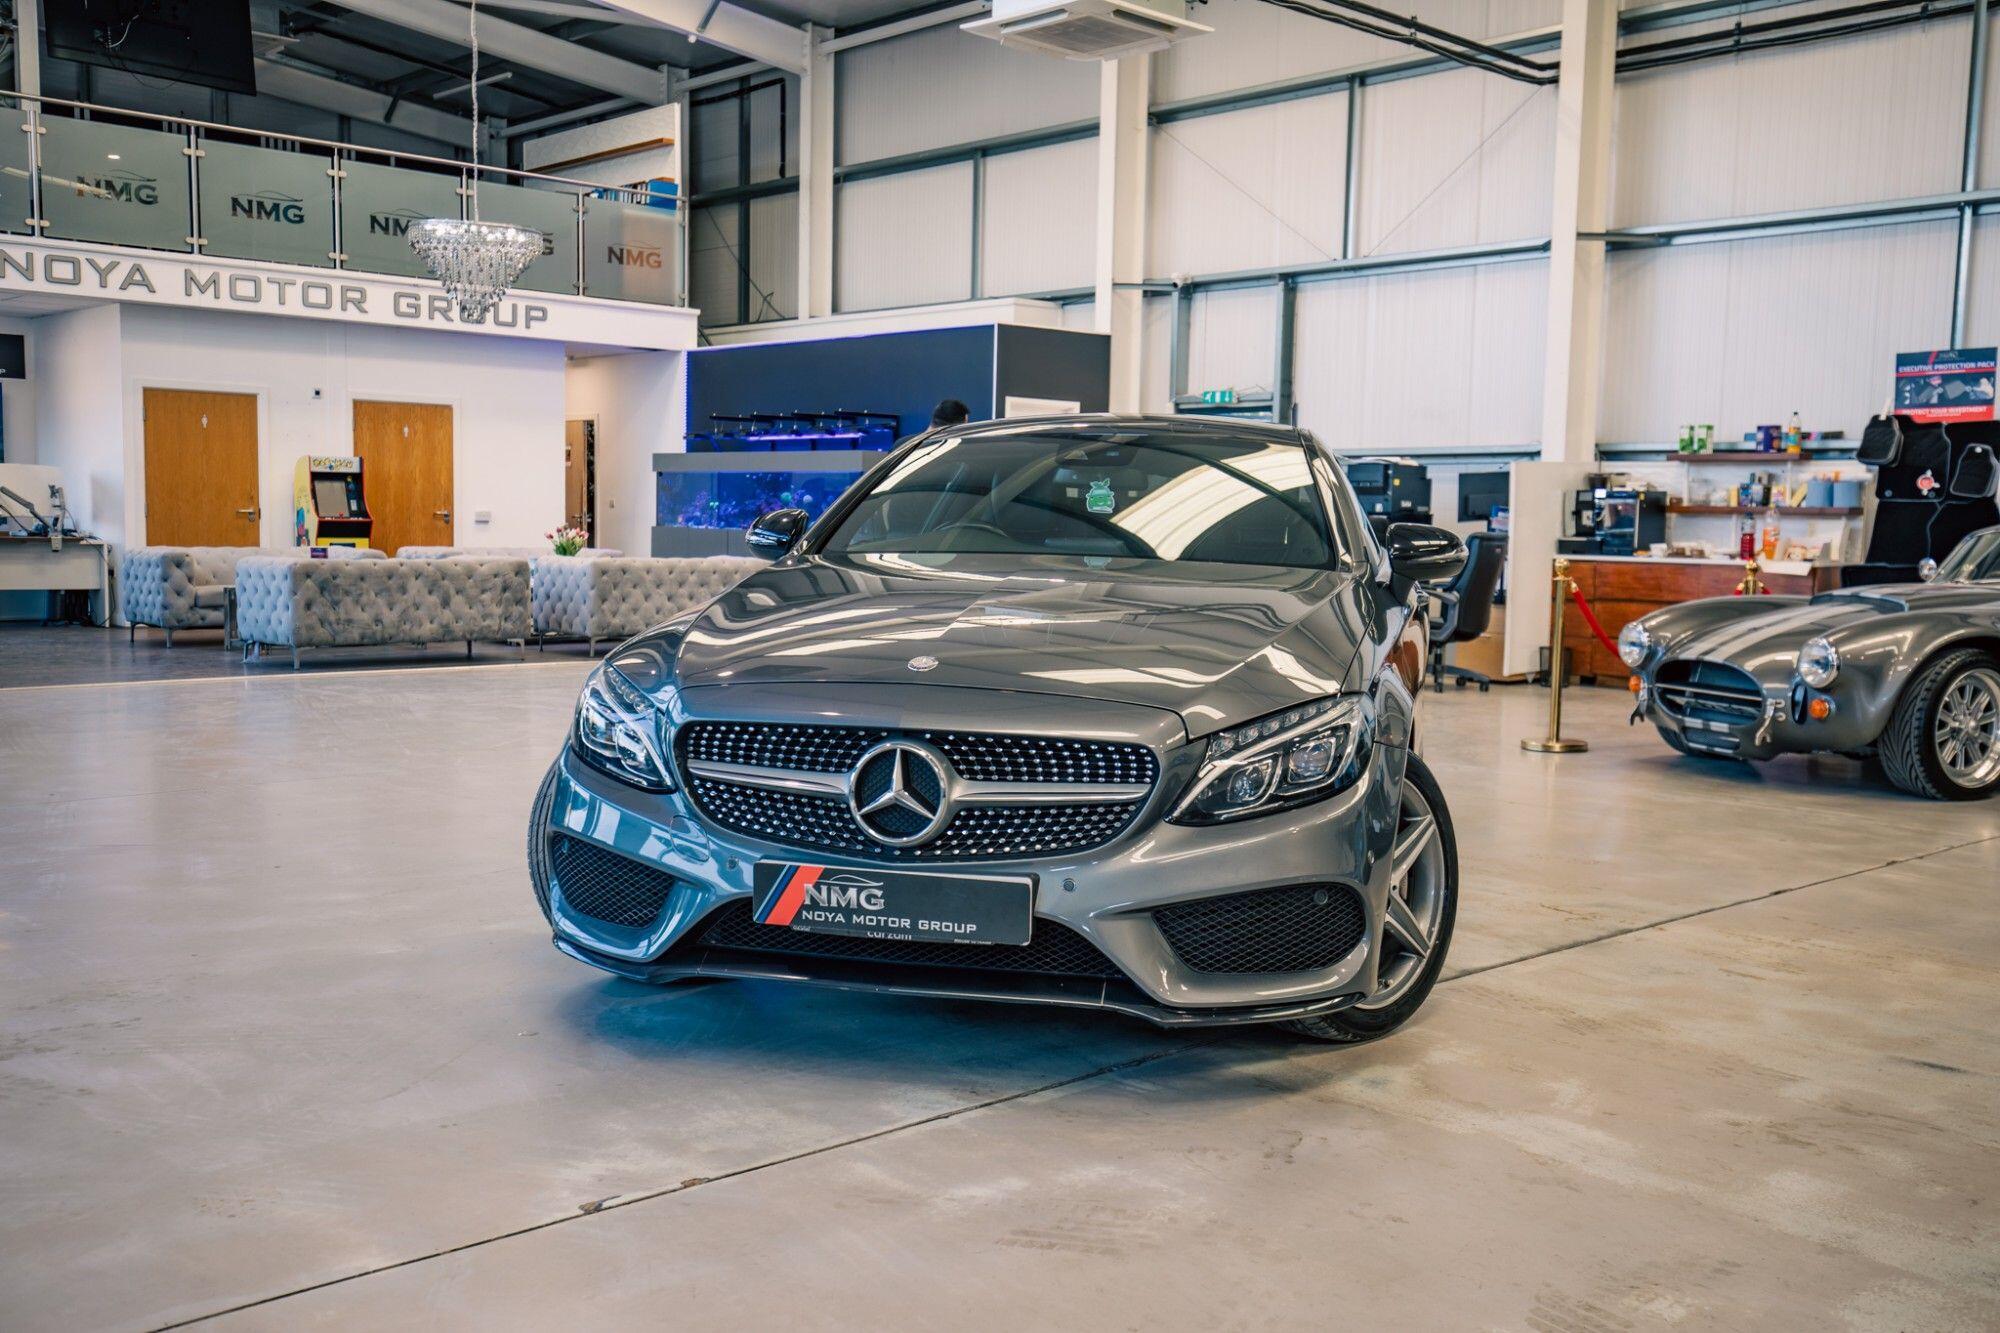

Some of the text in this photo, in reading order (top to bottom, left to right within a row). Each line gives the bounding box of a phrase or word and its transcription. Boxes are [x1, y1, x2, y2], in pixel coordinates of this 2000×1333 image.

[231, 197, 305, 224] NMG
[370, 215, 412, 237] NM
[607, 246, 662, 269] NMG
[0, 249, 156, 293] NOYA
[184, 268, 369, 314] MOTOR
[1934, 362, 1976, 370] PROTECTION
[803, 883, 885, 910] NMG
[802, 910, 977, 934] NOYA MOTOR GROUP
